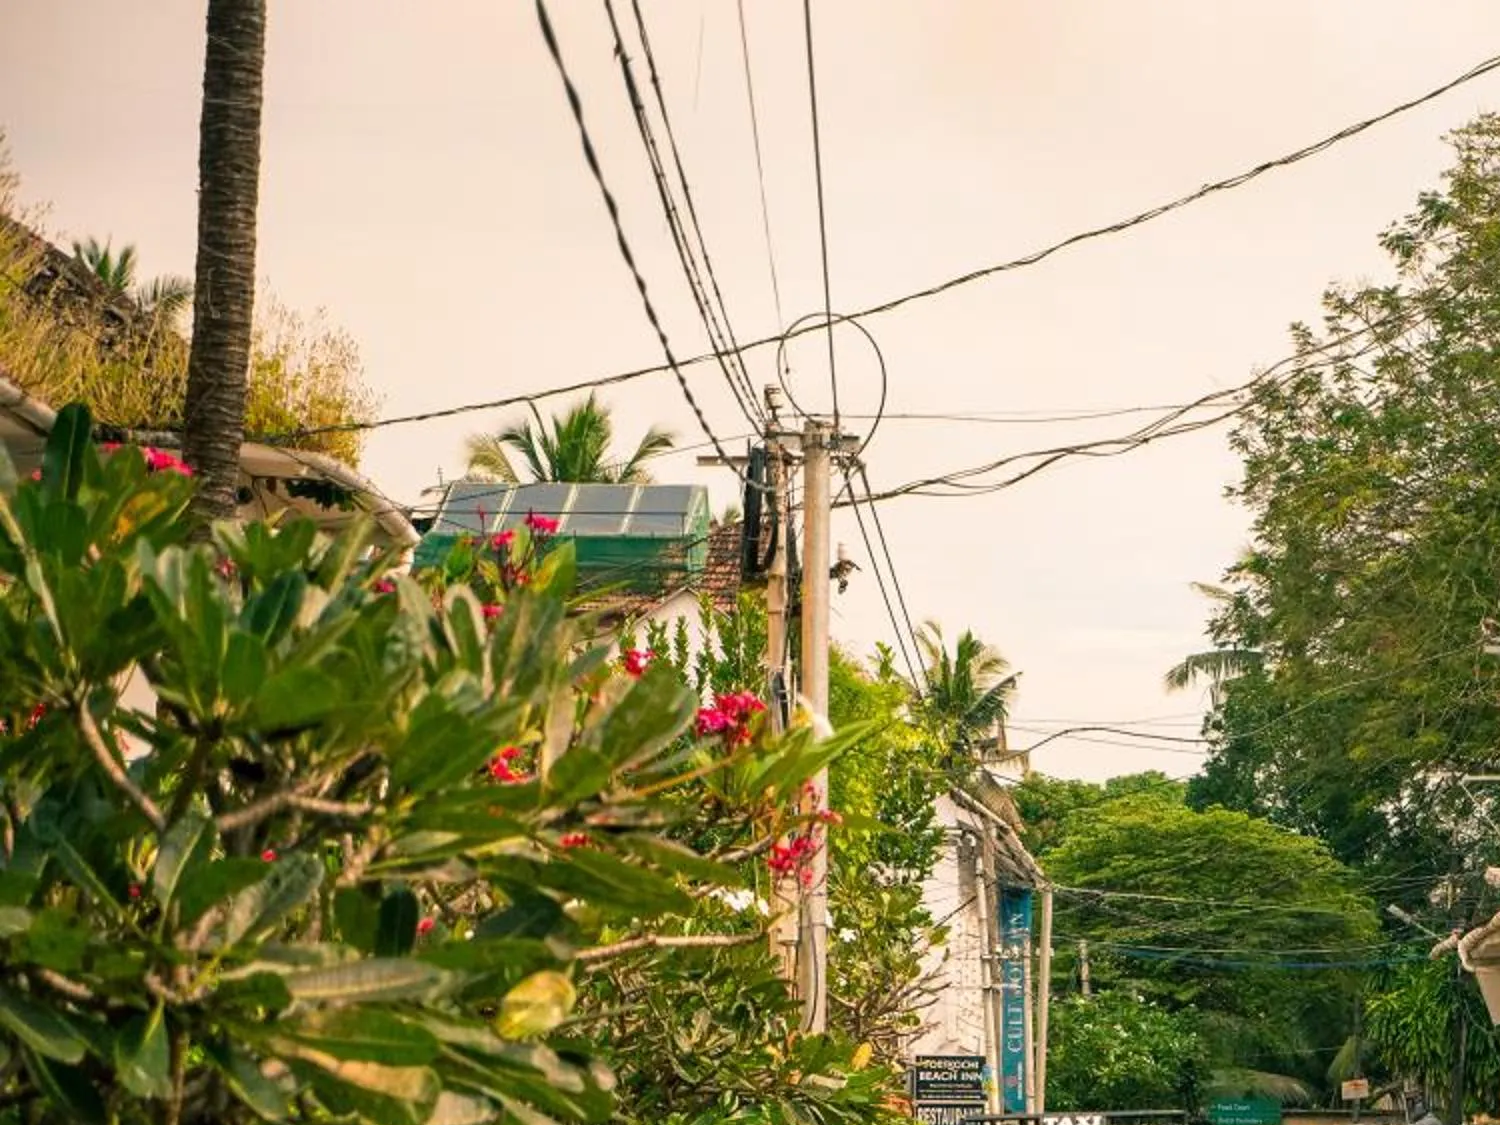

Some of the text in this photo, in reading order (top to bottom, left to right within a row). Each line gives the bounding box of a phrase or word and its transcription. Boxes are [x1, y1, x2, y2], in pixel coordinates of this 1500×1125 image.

[1007, 1003, 1023, 1053] CULT
[919, 1071, 983, 1081] BEACH INN
